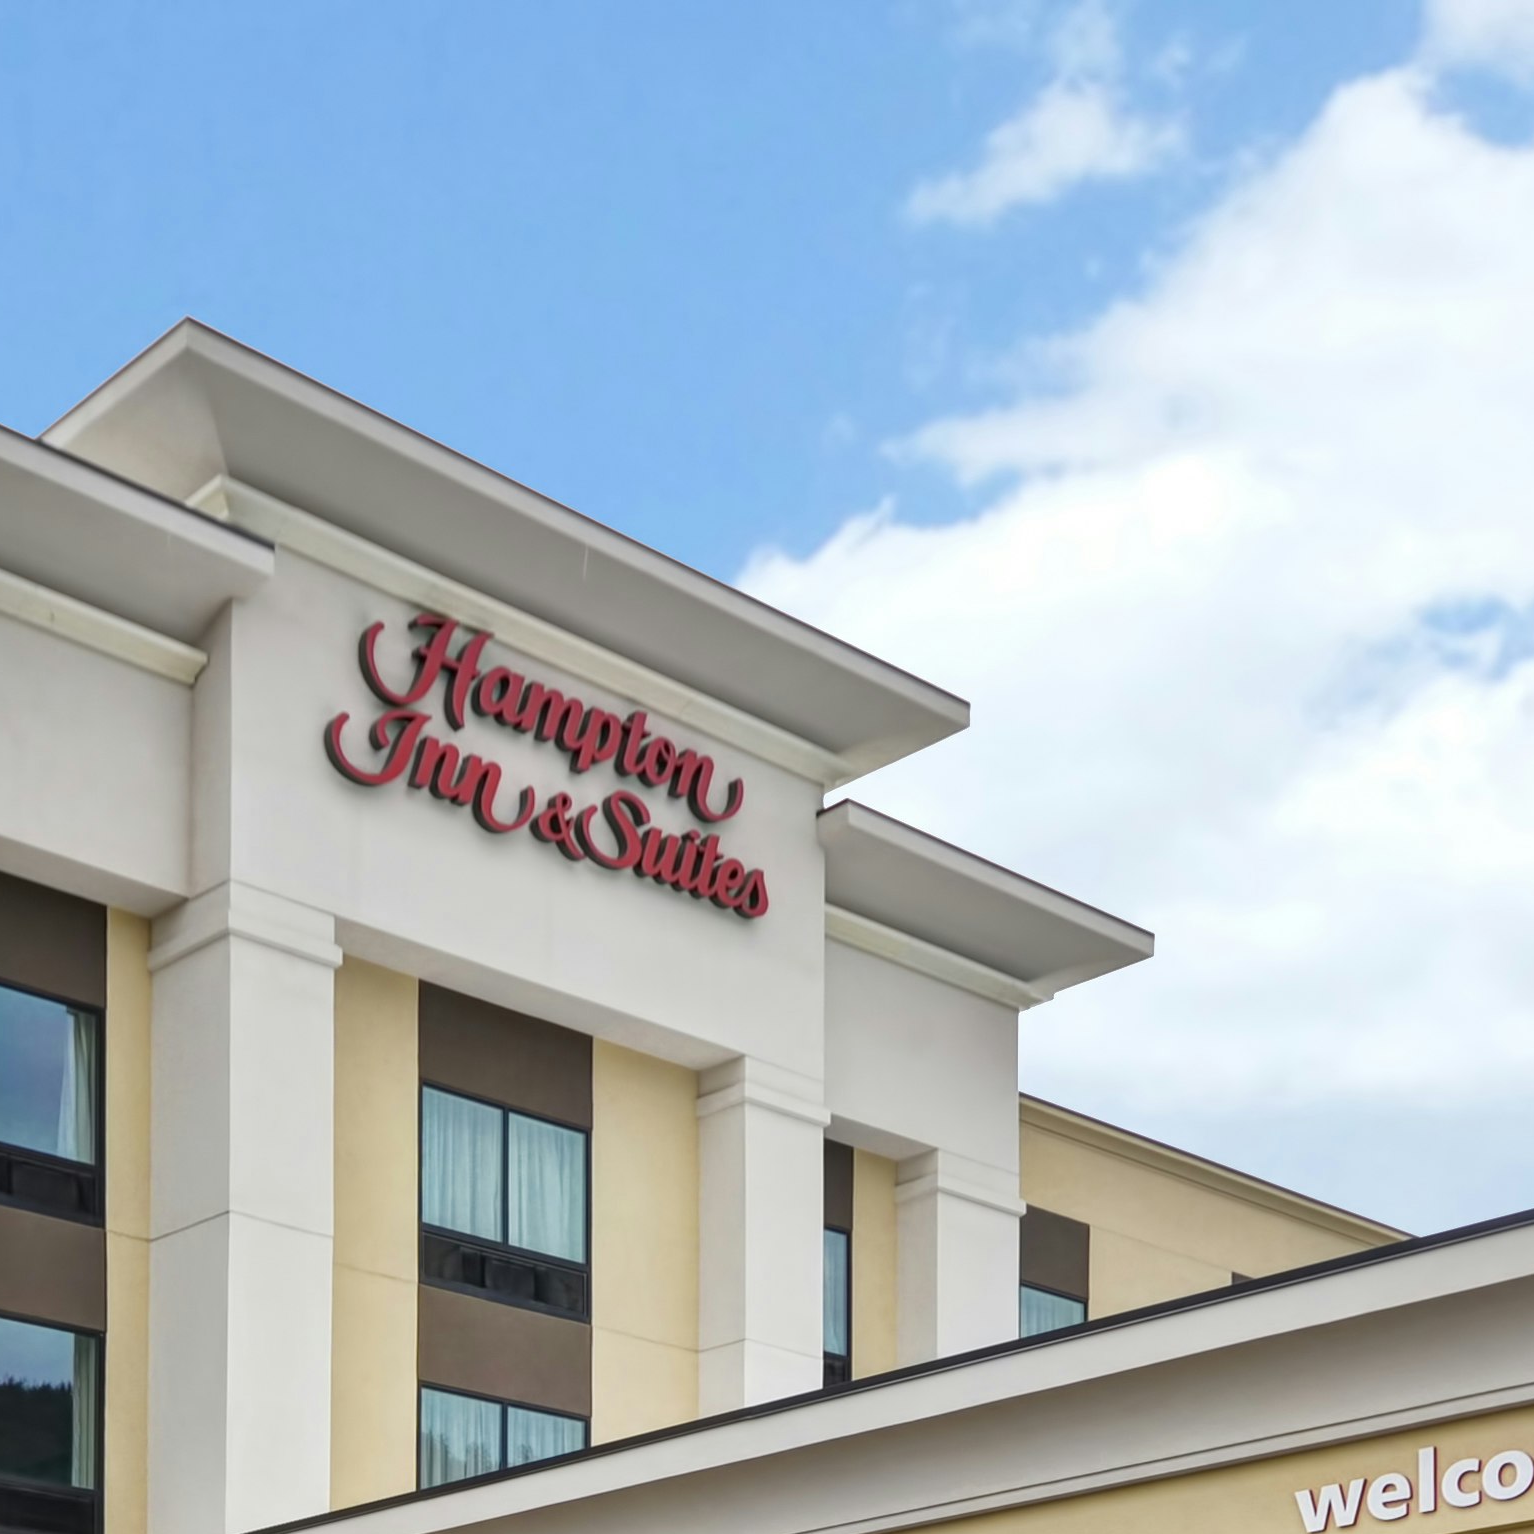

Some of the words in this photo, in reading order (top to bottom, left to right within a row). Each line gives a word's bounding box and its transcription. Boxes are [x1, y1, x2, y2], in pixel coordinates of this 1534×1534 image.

[324, 709, 536, 834] Inn
[529, 792, 585, 861] &
[574, 789, 769, 919] Suites
[358, 613, 744, 822] Hampton
